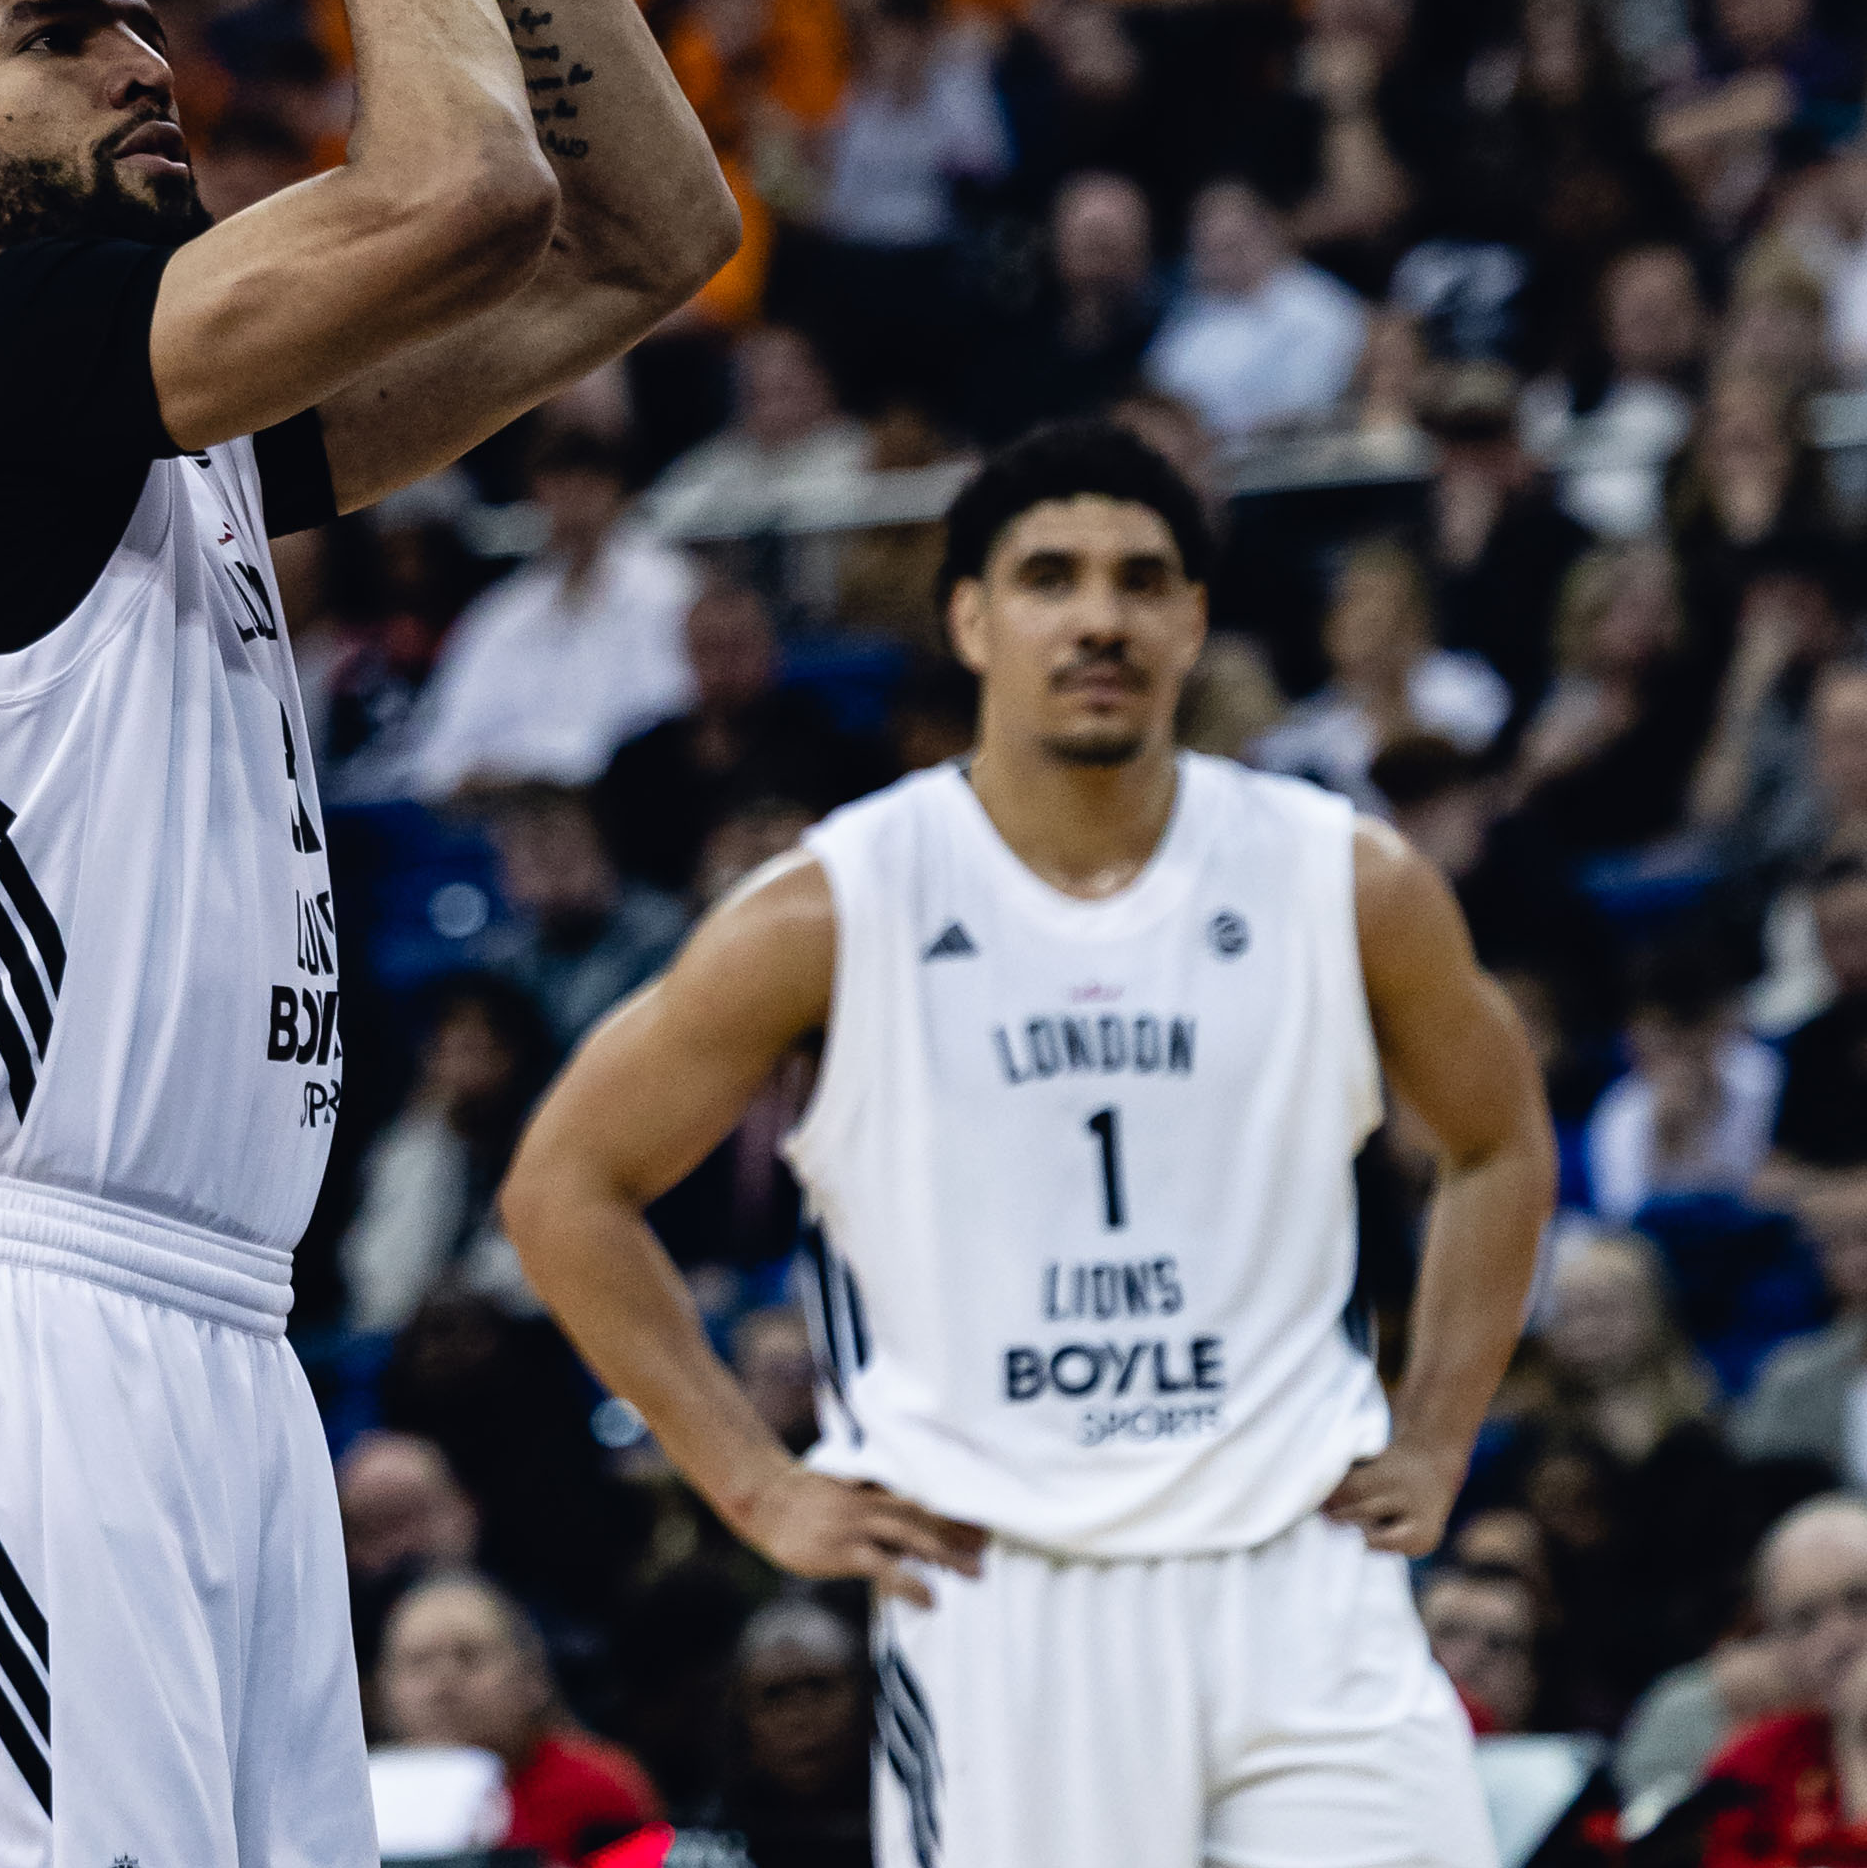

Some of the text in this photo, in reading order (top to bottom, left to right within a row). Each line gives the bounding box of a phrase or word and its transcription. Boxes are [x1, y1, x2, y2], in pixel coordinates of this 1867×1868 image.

[994, 1015, 1198, 1084] LONDON
[1085, 1106, 1127, 1230] 1
[1043, 1255, 1185, 1323] LIONS
[1004, 1336, 1225, 1401] BOYLE
